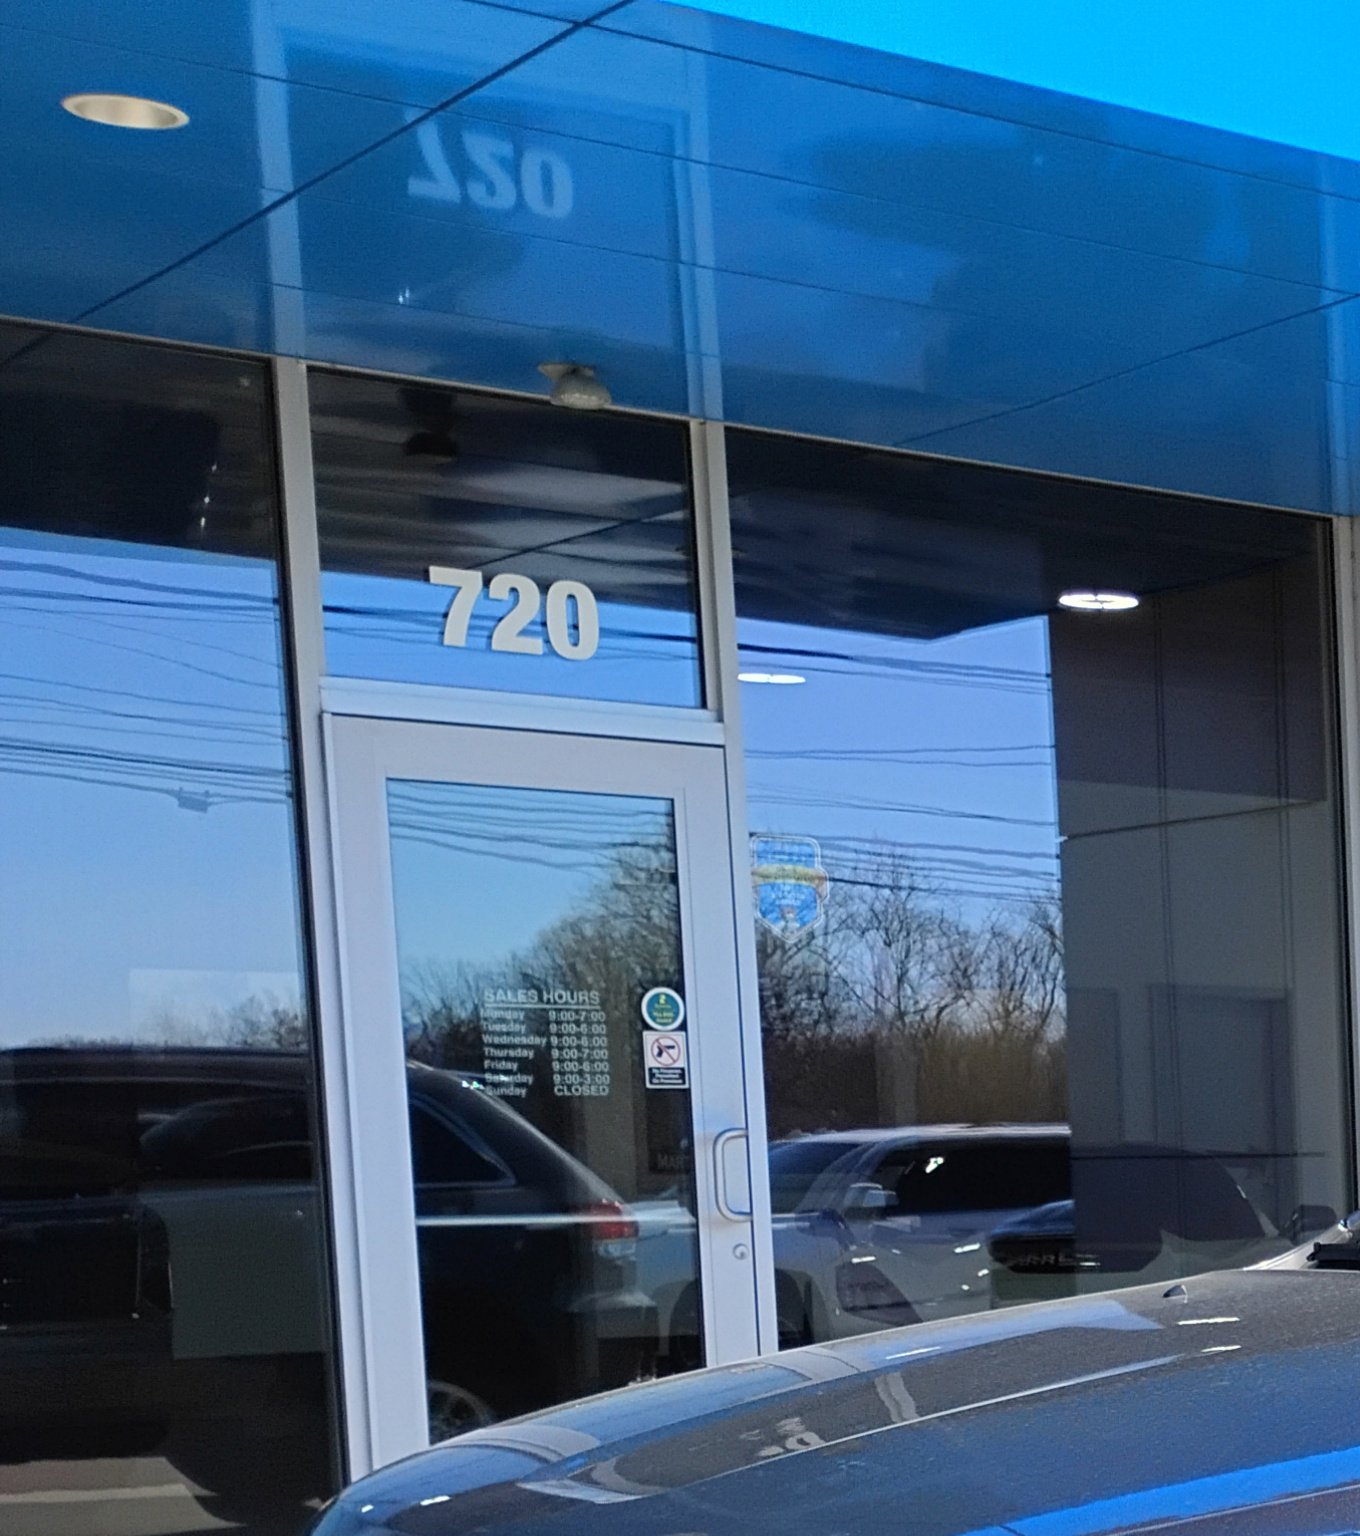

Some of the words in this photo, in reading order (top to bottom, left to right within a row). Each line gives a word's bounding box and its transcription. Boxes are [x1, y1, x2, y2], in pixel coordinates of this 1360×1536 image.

[429, 565, 599, 660] 720
[484, 989, 538, 1002] SALES
[543, 990, 600, 1004] HOURS
[480, 1009, 525, 1022] Monday
[549, 1011, 605, 1021] 9:00-7:00
[482, 1022, 526, 1033] Tuesday
[482, 1034, 547, 1047] Wednesday
[484, 1048, 534, 1060] Thursday
[551, 1048, 608, 1059] 9:00-7:00
[484, 1060, 518, 1072] Friday
[484, 1073, 534, 1084] Saturday
[484, 1086, 527, 1098] Sunday
[553, 1085, 609, 1096] CLOSED
